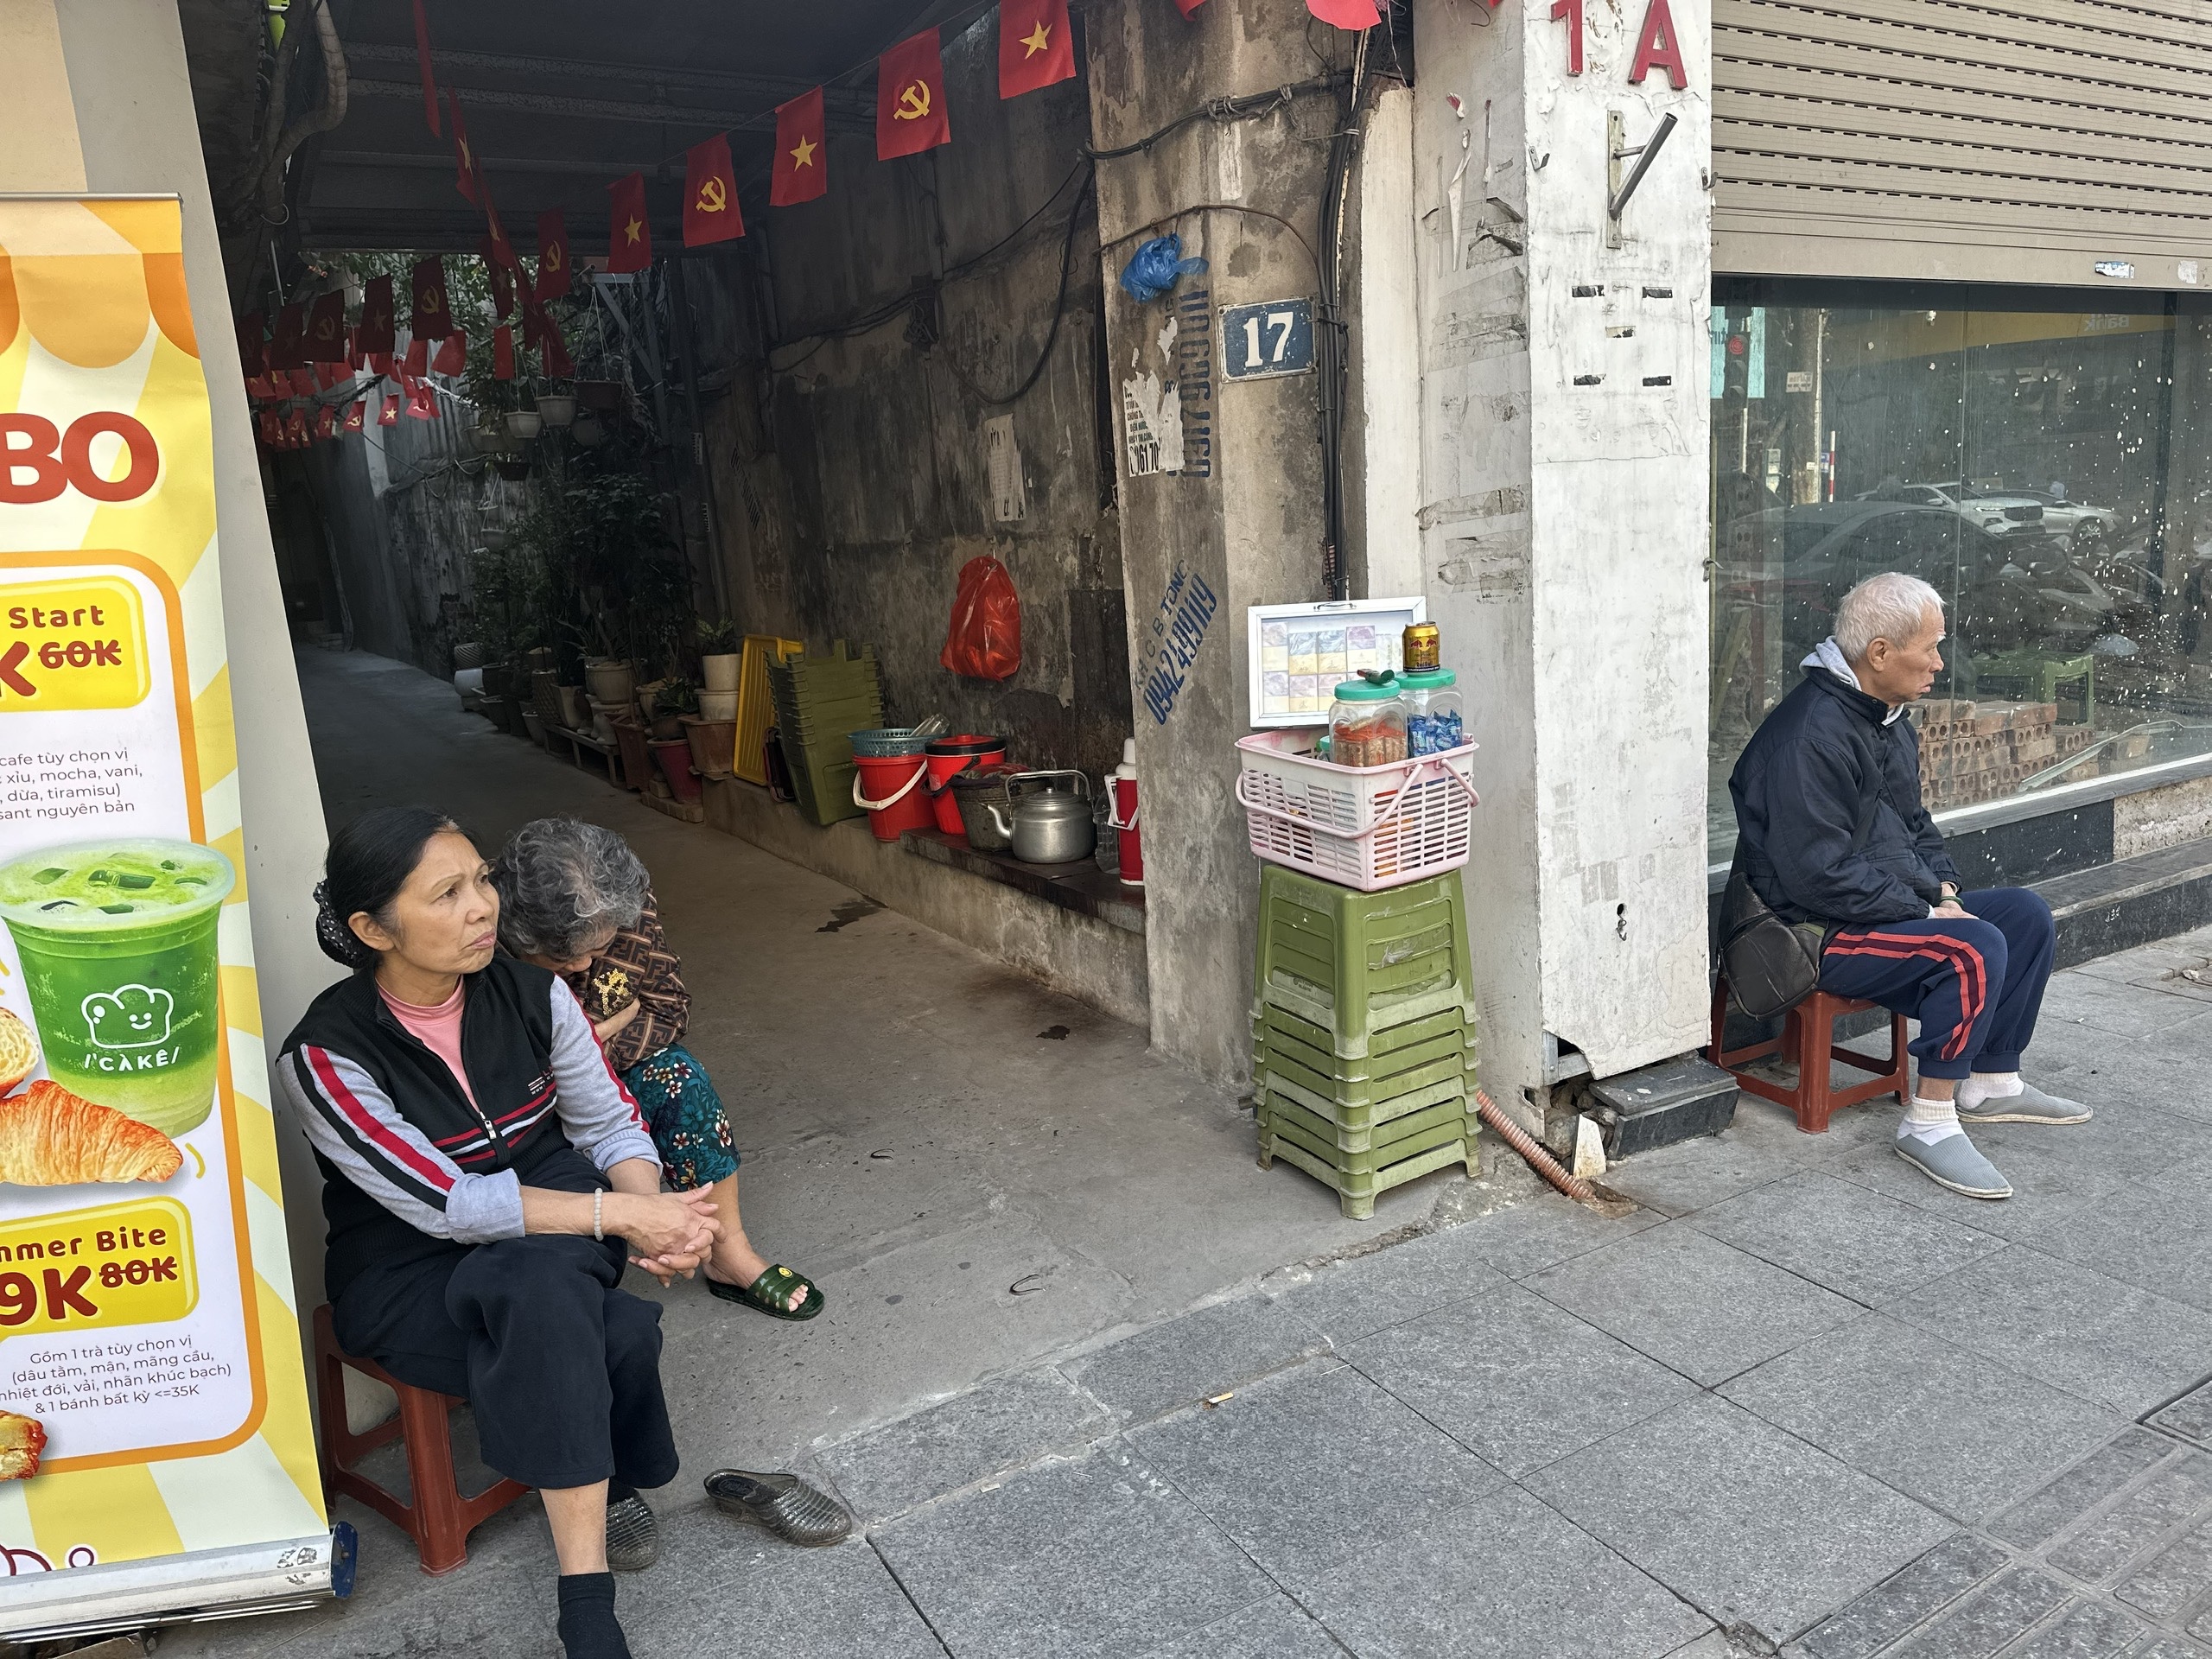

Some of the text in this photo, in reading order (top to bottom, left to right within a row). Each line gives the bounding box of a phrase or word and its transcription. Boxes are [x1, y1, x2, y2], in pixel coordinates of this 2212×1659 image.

[1243, 311, 1294, 367] 17
[0, 411, 160, 505] BO
[9, 605, 105, 629] Start
[38, 639, 123, 670] 60K
[1142, 572, 1217, 726] 0942499119
[0, 747, 129, 766] cafe tùy chọn vị
[6, 764, 143, 785] xỉu, mocha, vani,
[7, 782, 121, 802] dừa, tiramisu)
[36, 803, 99, 820] nguyên
[104, 799, 135, 813] bản
[96, 1225, 167, 1252] Bite
[0, 1255, 178, 1326] 9K 80K
[29, 1334, 192, 1364] Gồm 1 trà tùy chọn vị
[0, 1363, 232, 1402] nhiệt đới, vải, nhãn khúc bạch)
[12, 1350, 214, 1386] (dâu tằm, mận, mãng cầu,
[35, 1384, 200, 1414] & 1 bánh bất kỳ <=35K
